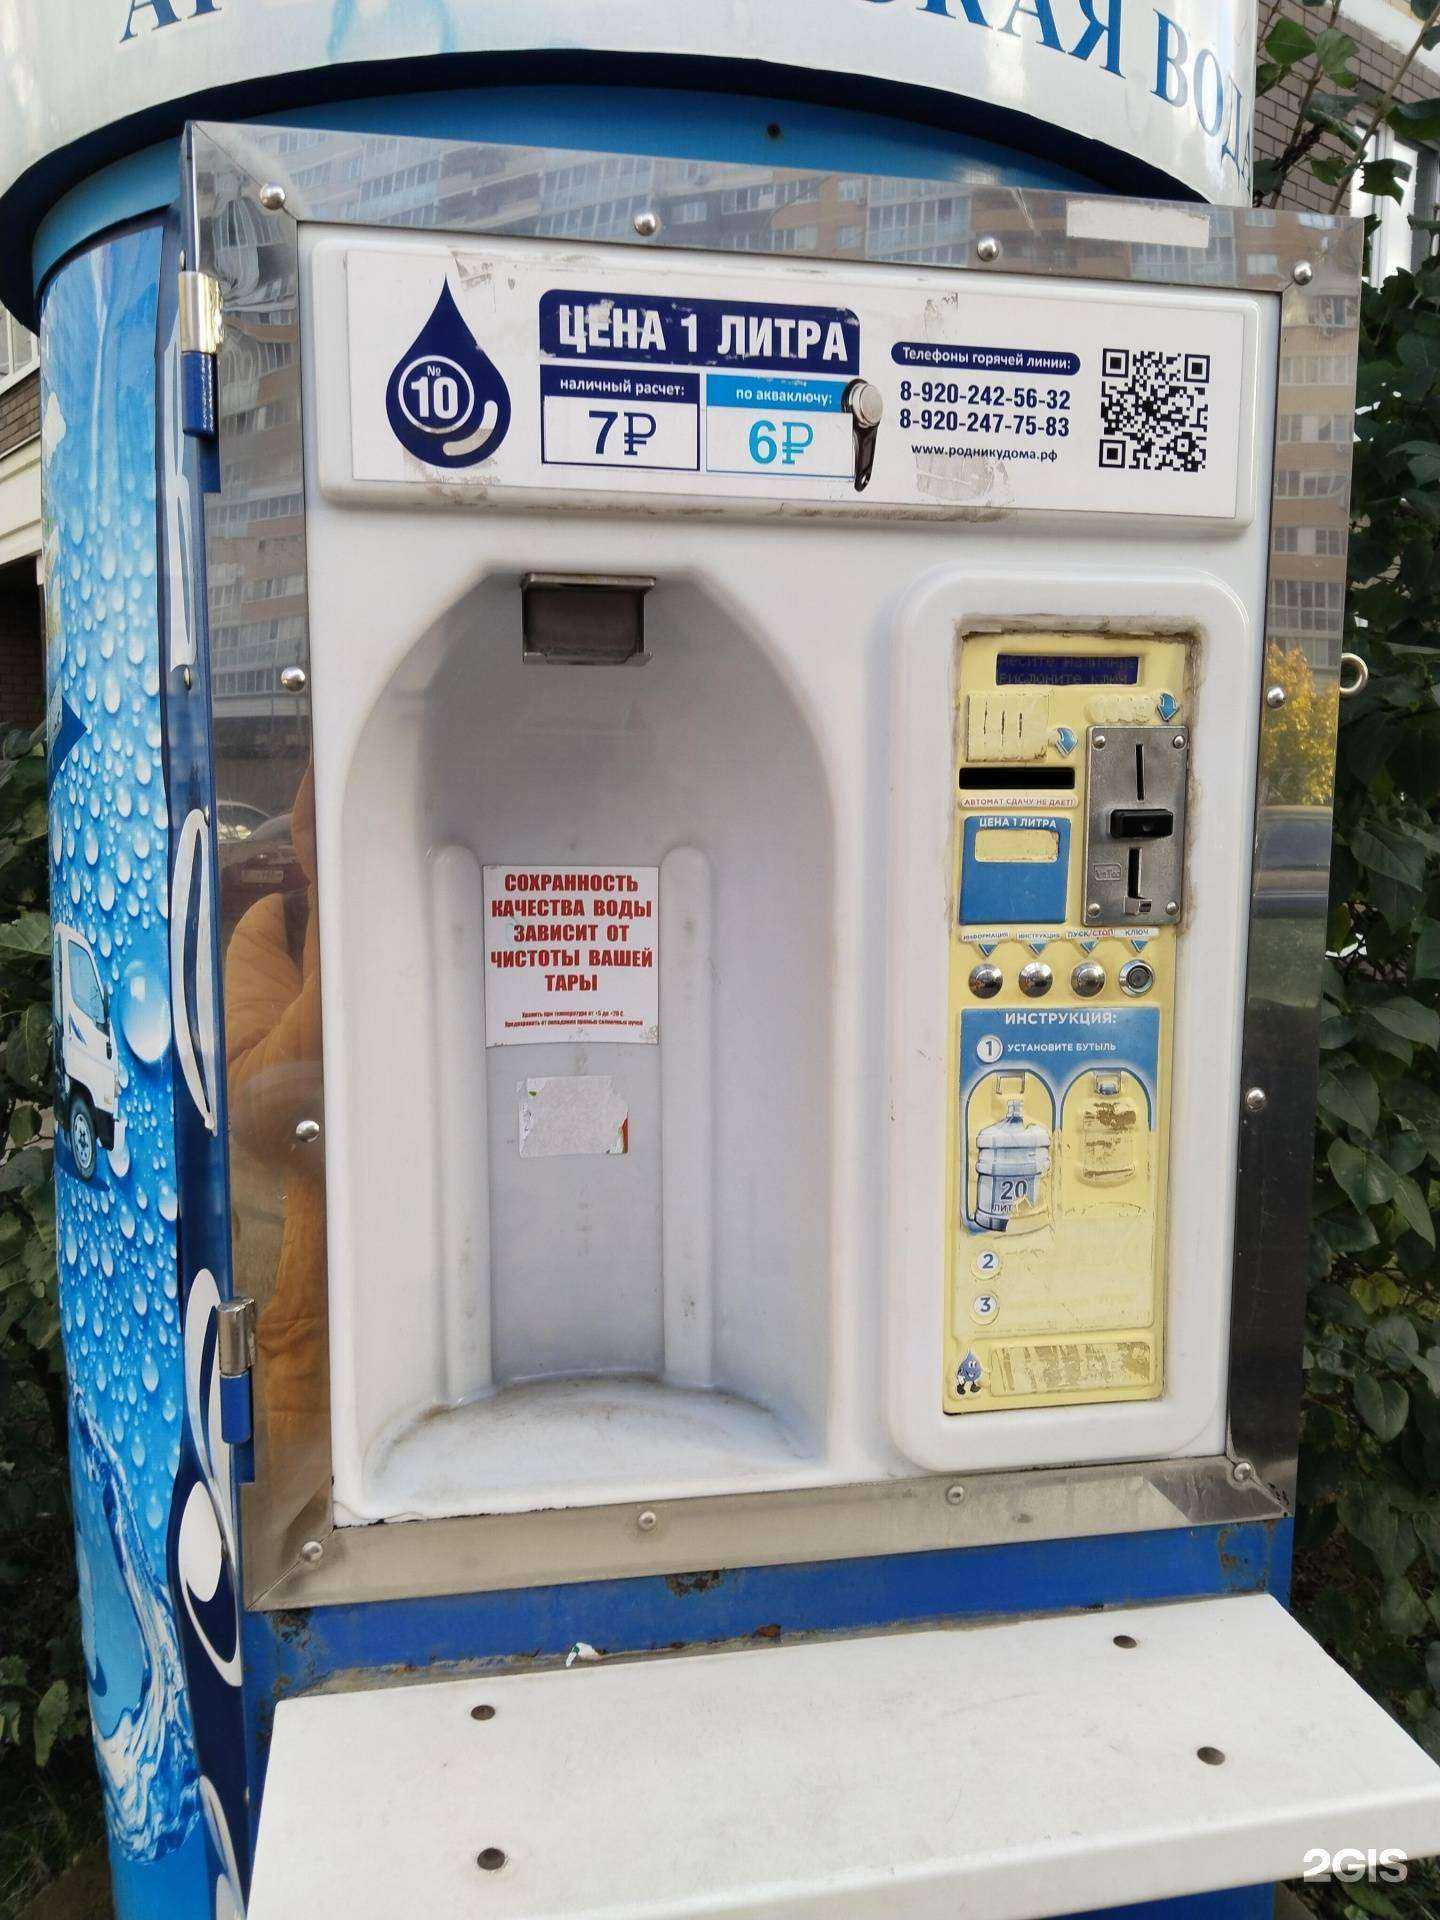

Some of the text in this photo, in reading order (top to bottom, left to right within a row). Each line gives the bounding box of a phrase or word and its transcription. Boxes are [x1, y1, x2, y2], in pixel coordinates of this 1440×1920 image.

[558, 303, 848, 362] ЦЕНА 1 ЛИТРА
[902, 346, 1071, 369] Телефоны горячей линии:
[426, 364, 442, 378] №
[559, 378, 686, 398] наличный расчет:
[736, 388, 833, 407] по акваключу:
[899, 380, 1071, 410] 8-920-242-56-32
[410, 378, 459, 420] 10
[899, 408, 1070, 437] 8-920-247-75-83
[588, 410, 658, 456] 7₽
[748, 419, 815, 465] 6₽
[911, 443, 1058, 462] www.родникудома.рф
[964, 798, 1004, 807] АВТОМАТ
[1006, 798, 1034, 807] СДАЧУ
[980, 818, 1057, 829] ЦЕНА 1 ЛИТРА
[504, 874, 639, 892] СОХРАННОСТЬ
[491, 899, 653, 919] КАЧЕСТВА ВОДЫ
[513, 924, 630, 942] ЗАВИСИТ ОТ
[1067, 928, 1114, 938] ПУСК/СТОП
[1125, 928, 1149, 937] КЛЮЧ
[490, 948, 653, 968] ЧИСТОТЫ ВАШЕЙ
[544, 974, 598, 991] ТАРЫ
[1004, 1012, 1117, 1026] ИНСТРУКЦИЯ:
[985, 1040, 1117, 1056] 1 УСТАНОВИТЕ БУТЫЛЬ
[1000, 1180, 1028, 1200] 20
[982, 1253, 994, 1269] 2
[980, 1296, 991, 1312] 3
